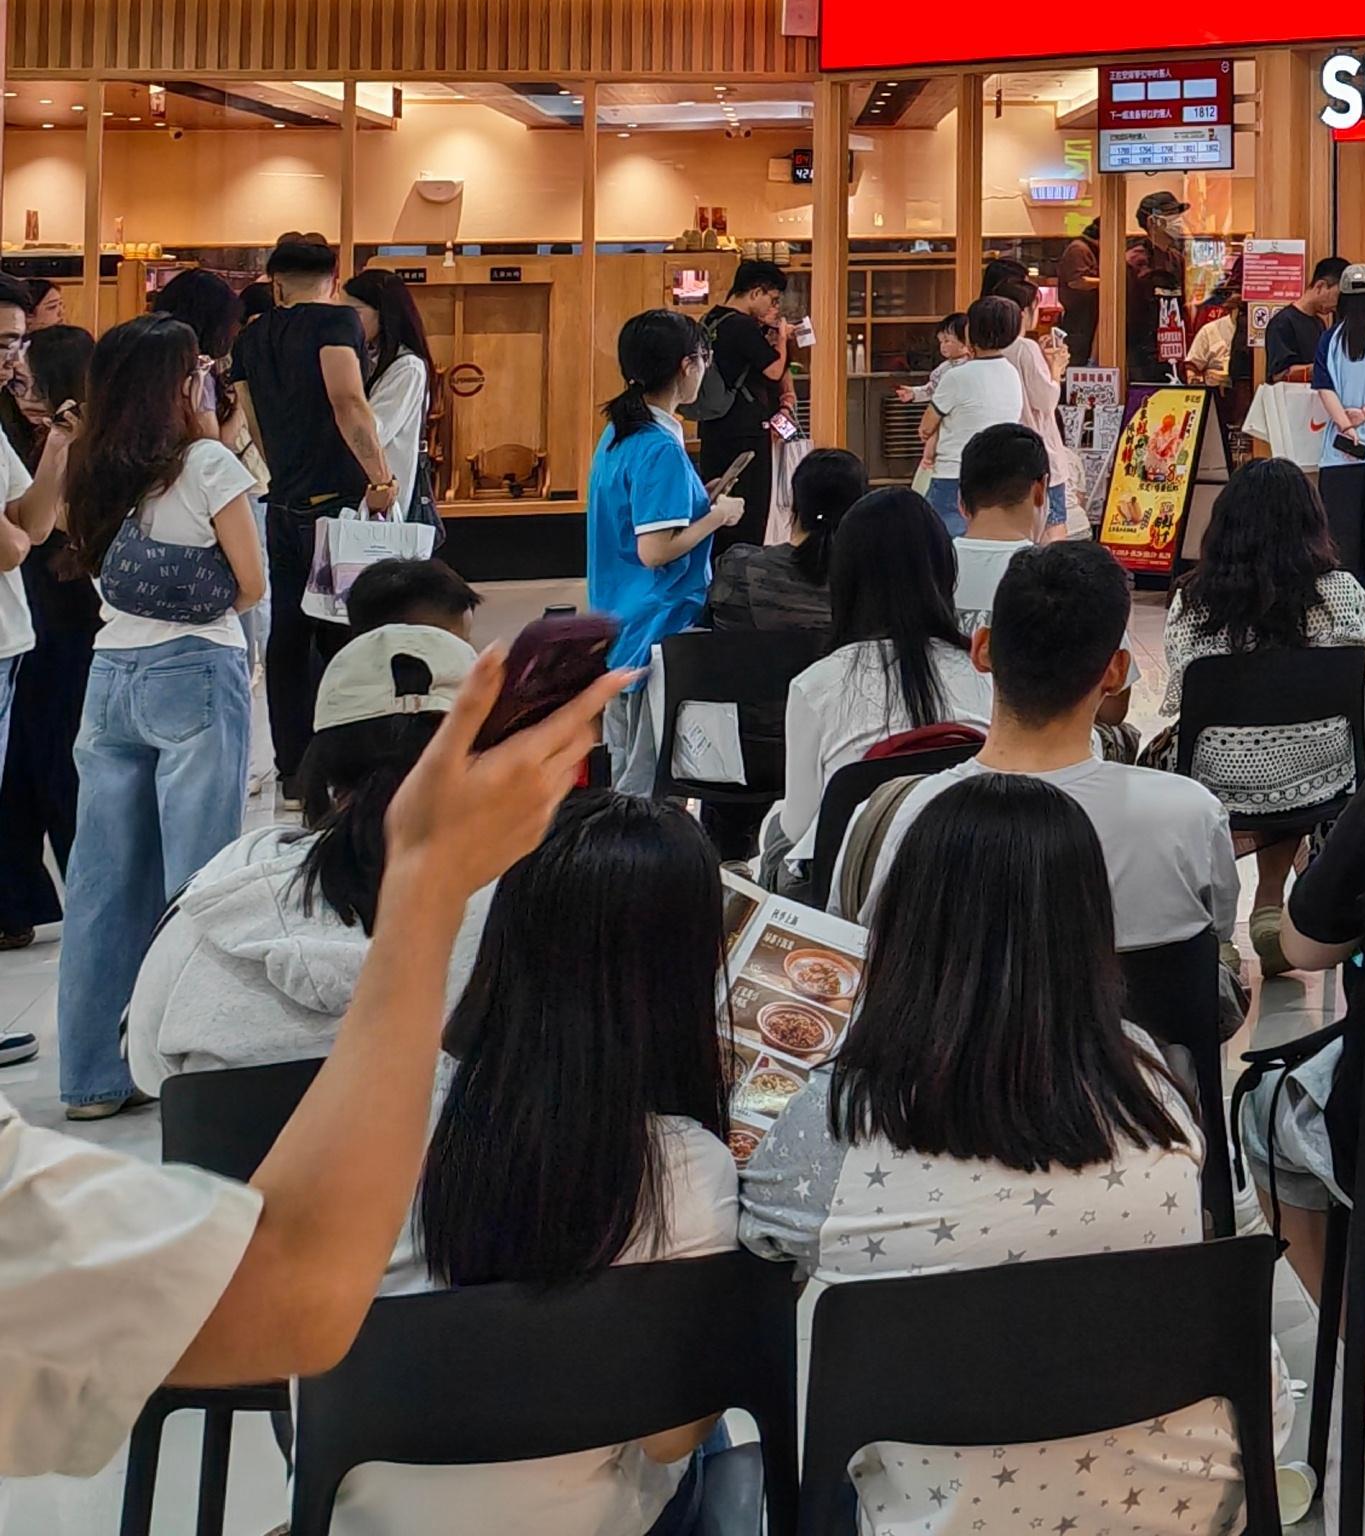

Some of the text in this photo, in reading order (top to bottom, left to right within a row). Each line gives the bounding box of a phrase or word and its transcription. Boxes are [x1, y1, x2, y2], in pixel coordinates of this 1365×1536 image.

[1194, 106, 1215, 118] 1812
[146, 547, 167, 559] NY
[160, 565, 180, 578] NY
